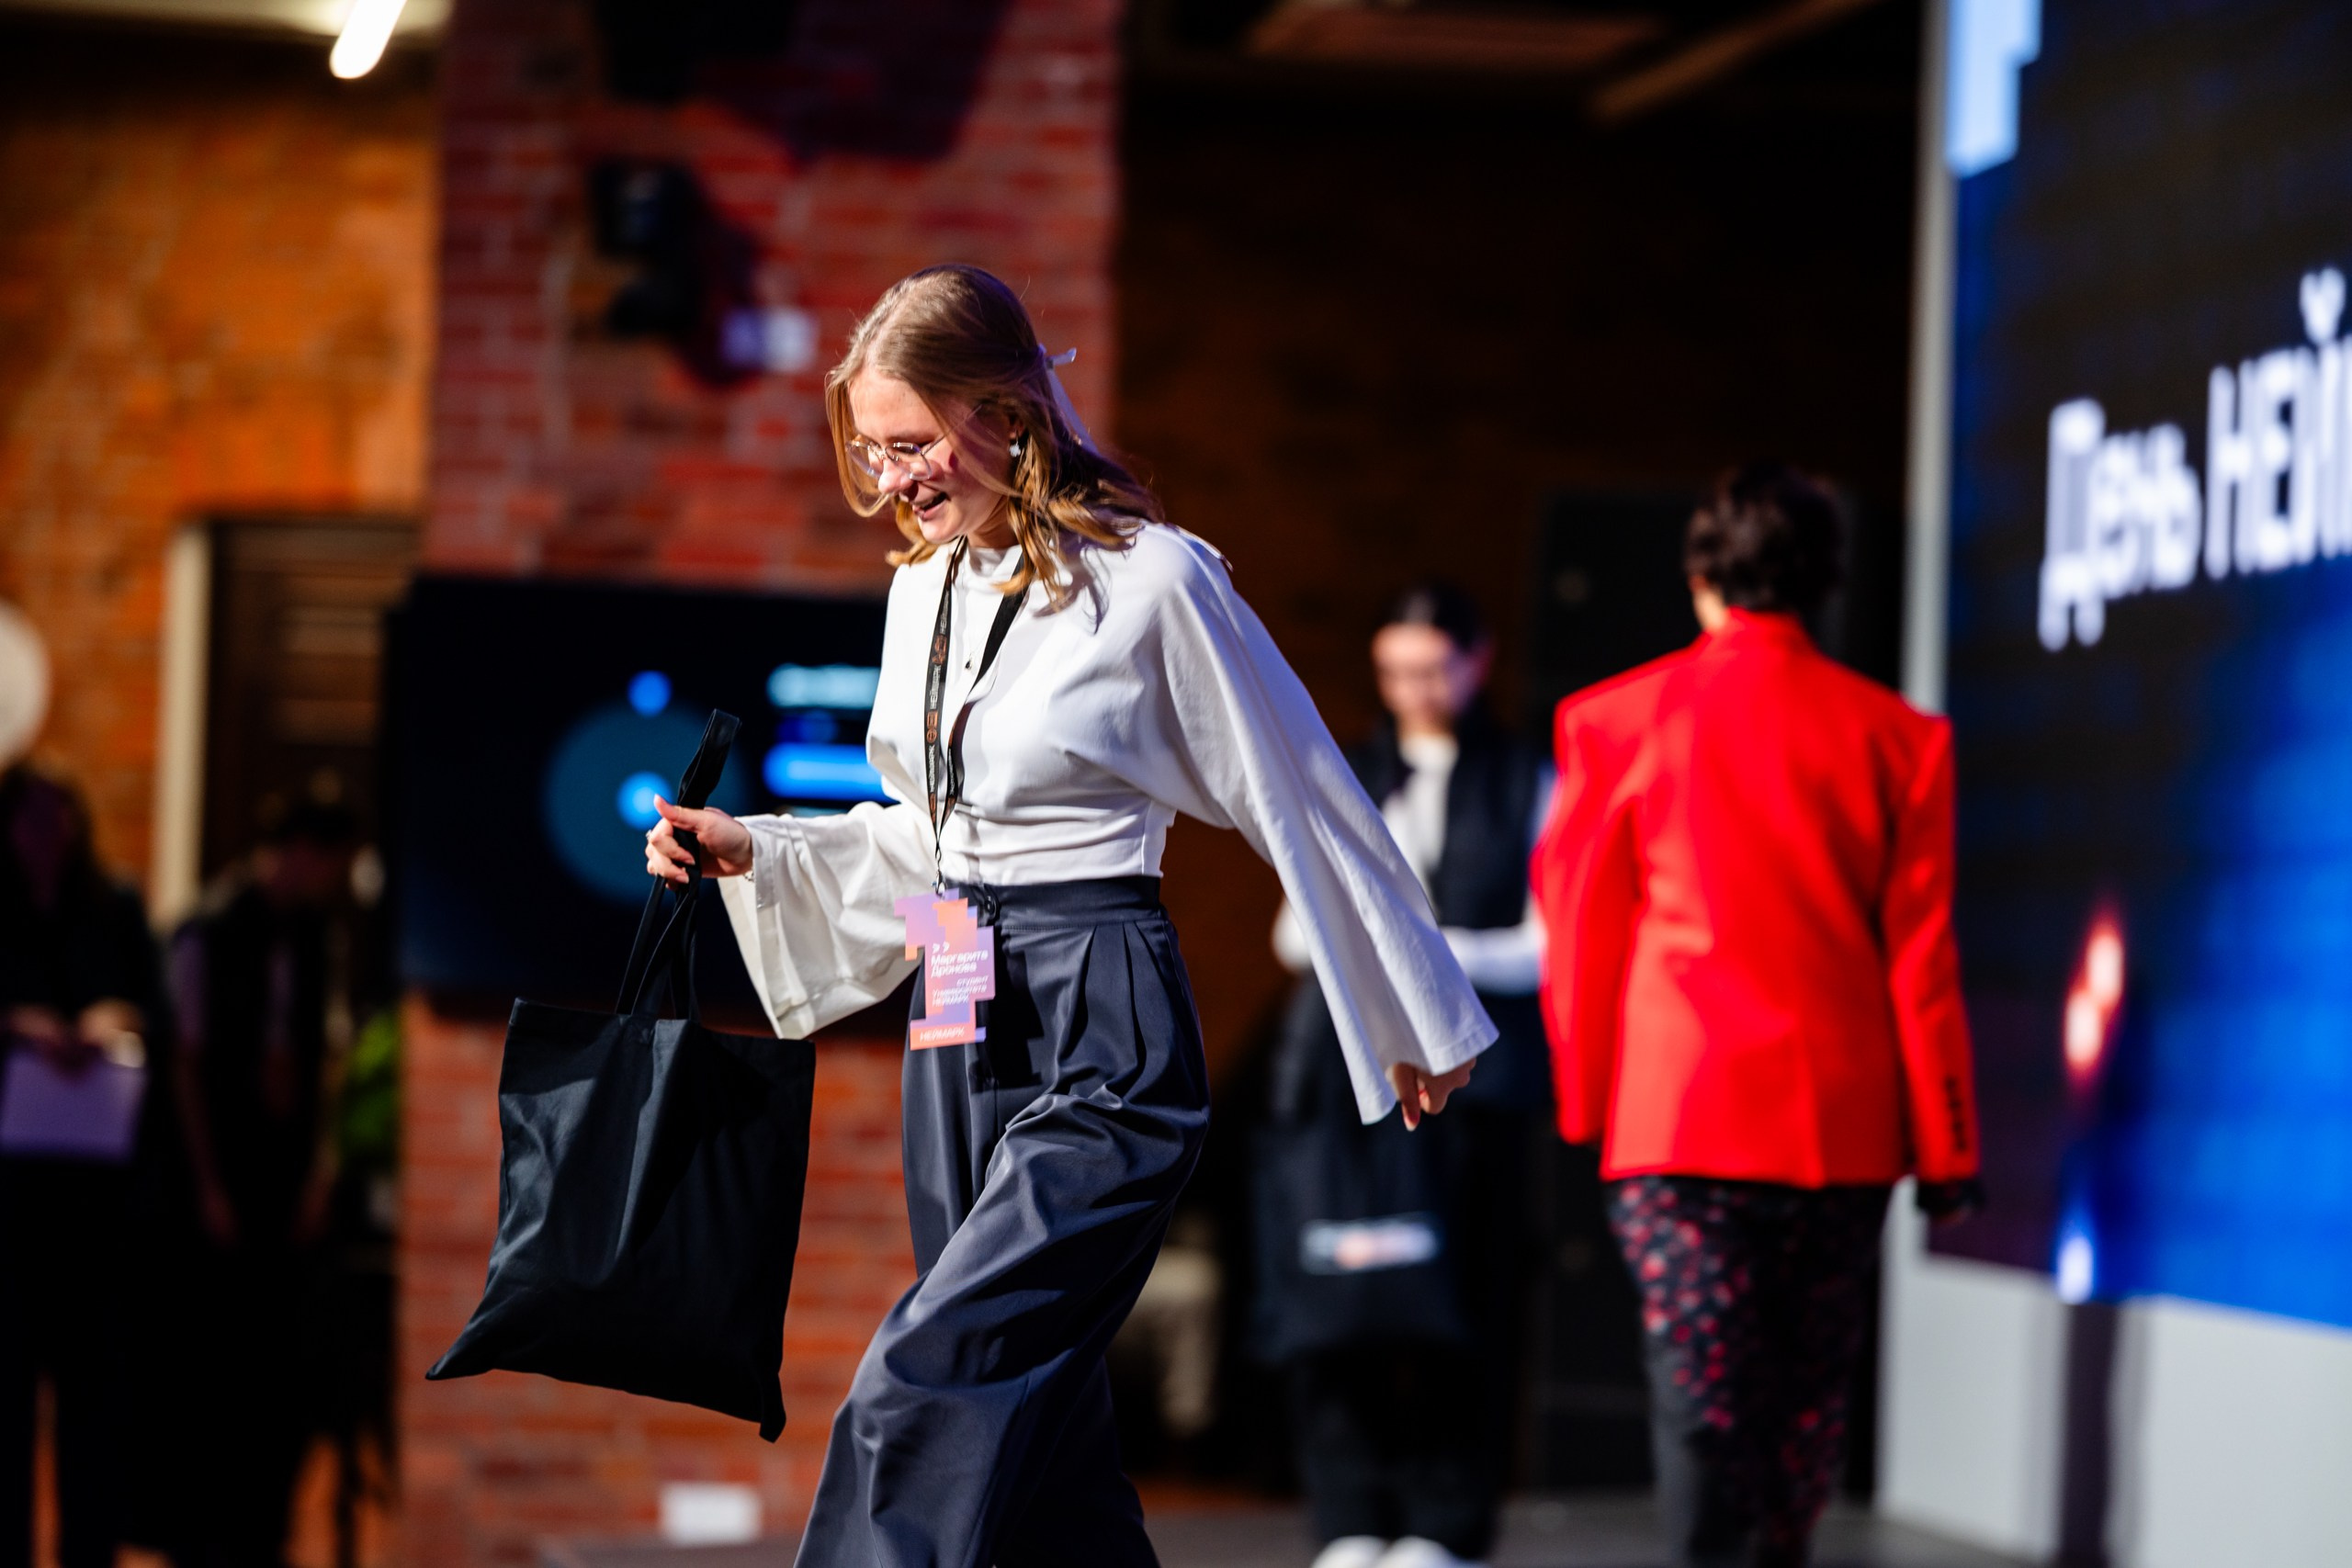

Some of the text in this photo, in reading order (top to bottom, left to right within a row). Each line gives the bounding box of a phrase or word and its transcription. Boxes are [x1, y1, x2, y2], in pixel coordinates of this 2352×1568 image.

[2038, 267, 2352, 651] День НЕЙ
[929, 664, 942, 710] НЕЙМАРК
[932, 951, 988, 965] Маргарита
